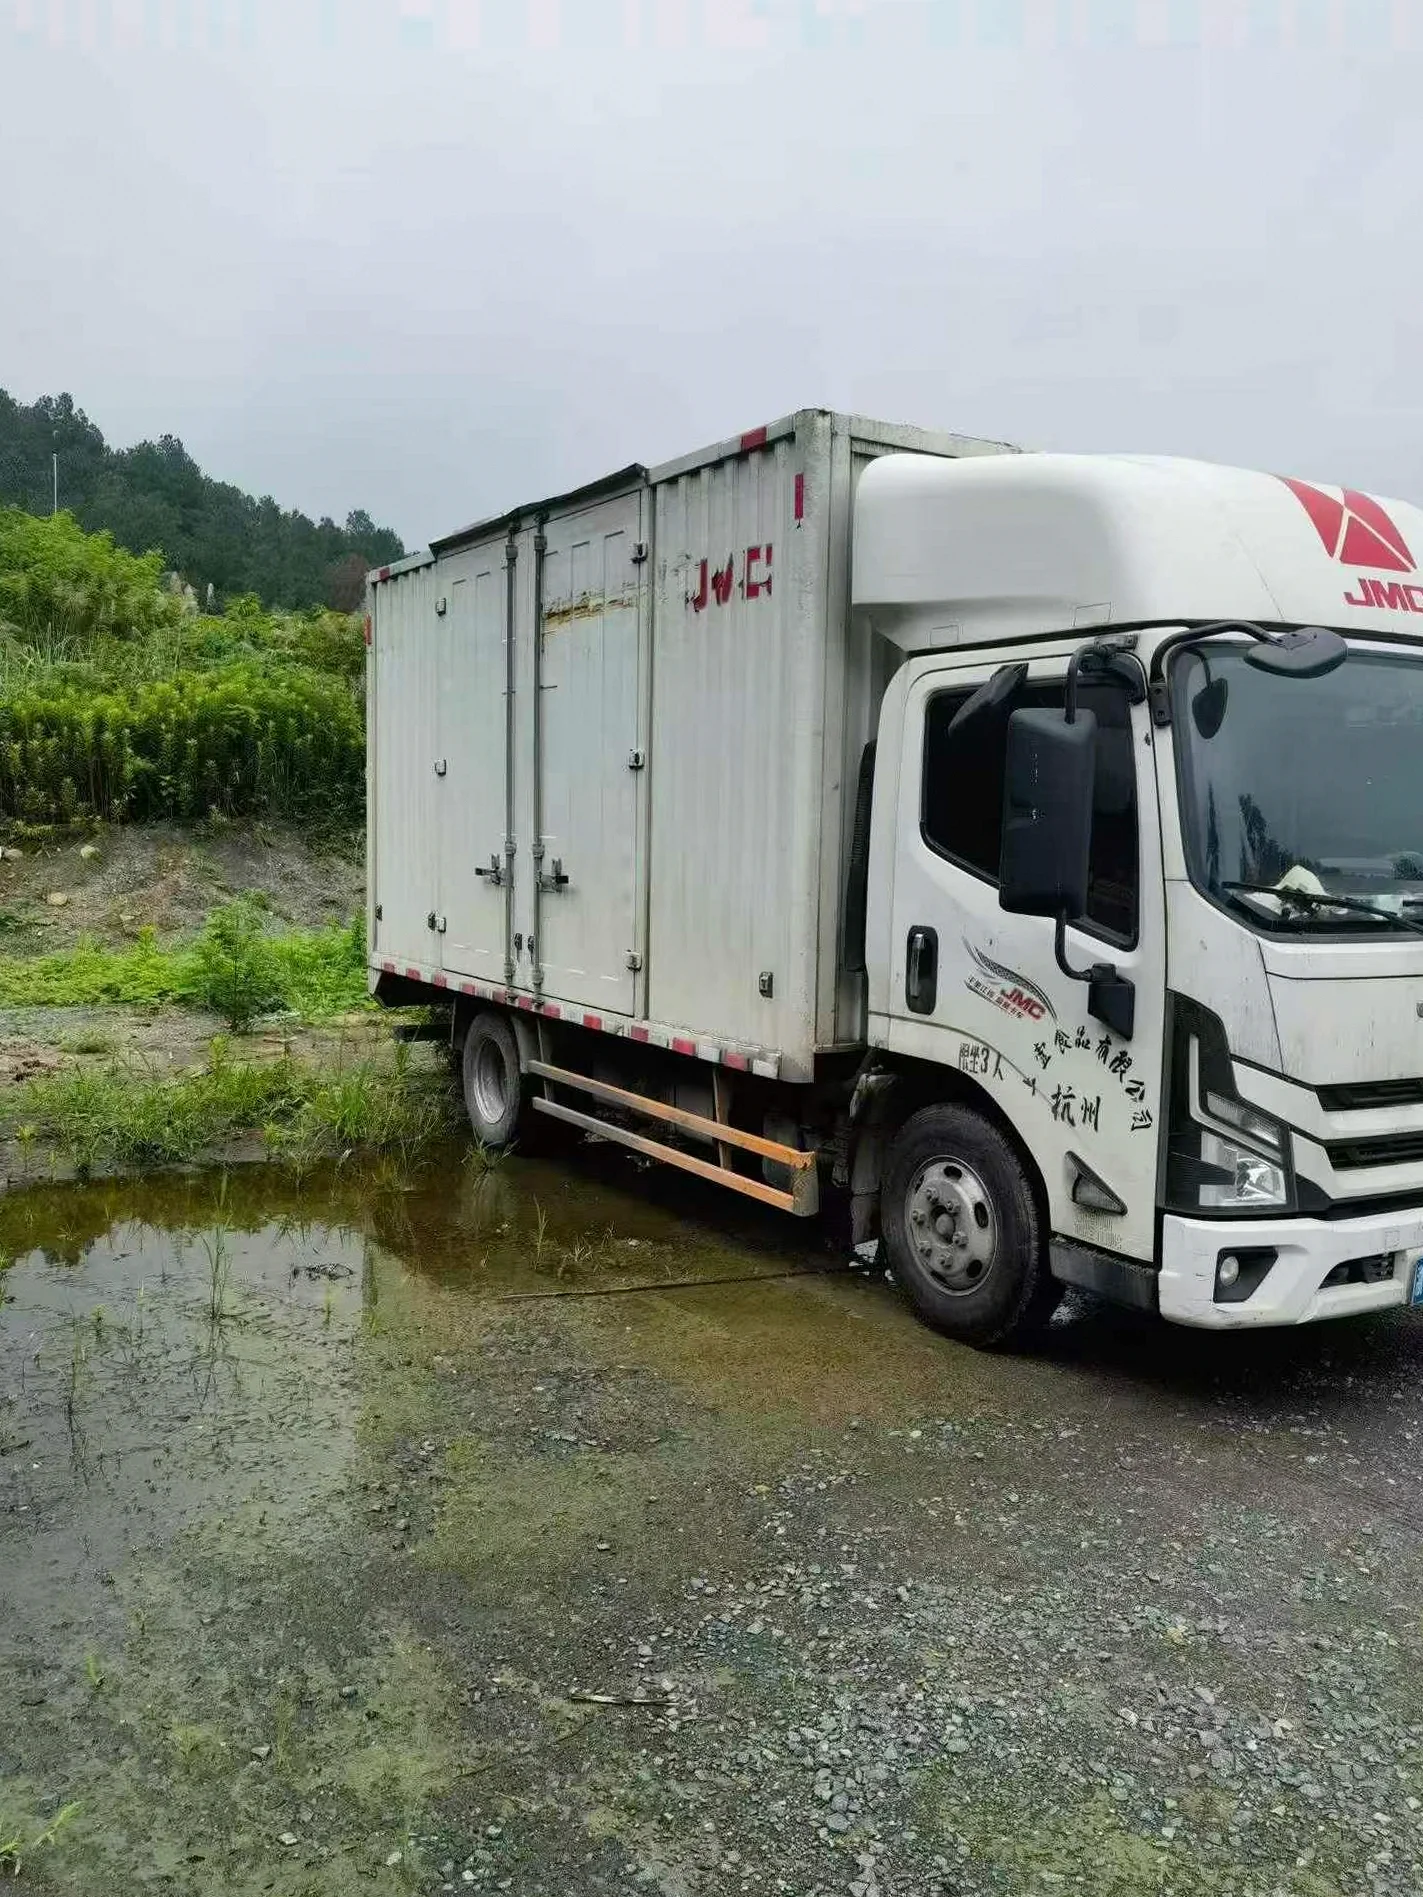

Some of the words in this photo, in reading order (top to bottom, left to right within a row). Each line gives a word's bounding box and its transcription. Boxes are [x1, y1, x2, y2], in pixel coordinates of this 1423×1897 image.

[1343, 577, 1423, 614] JMC
[1001, 987, 1046, 1020] JMC
[1051, 1083, 1101, 1132] 杭州
